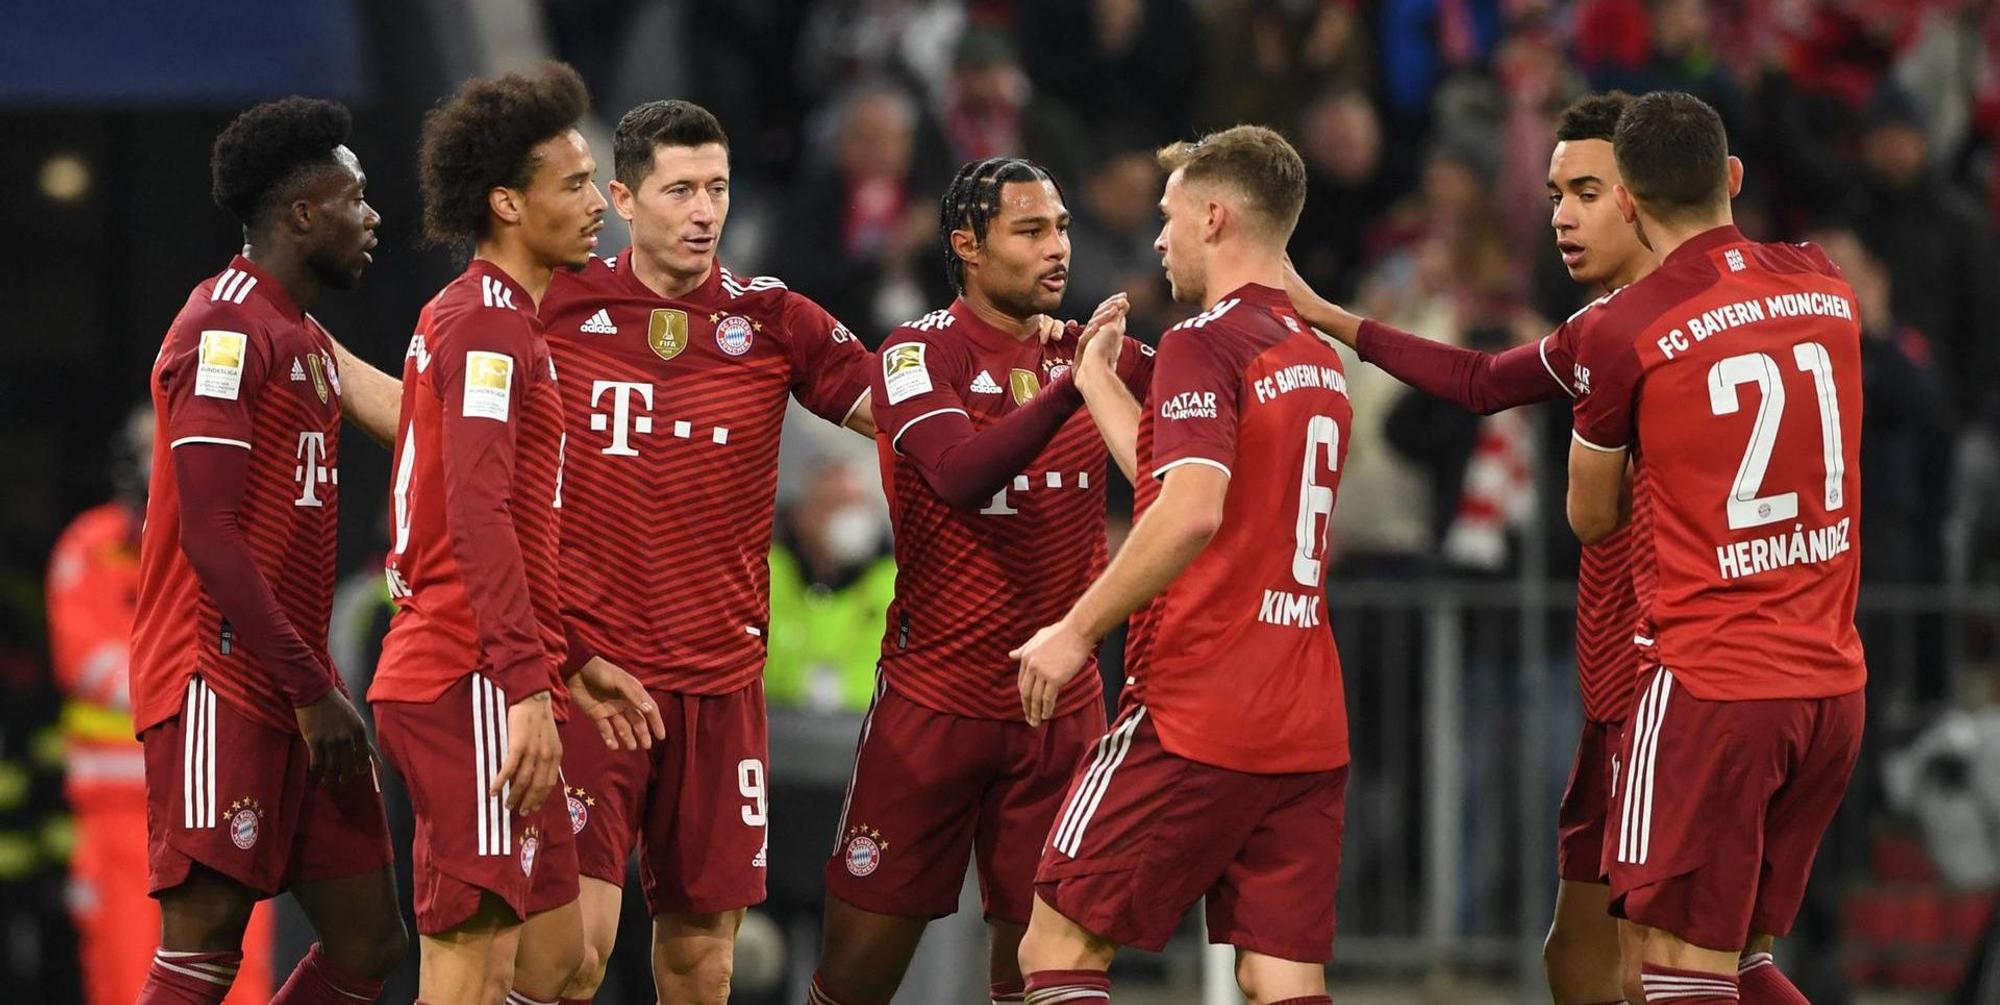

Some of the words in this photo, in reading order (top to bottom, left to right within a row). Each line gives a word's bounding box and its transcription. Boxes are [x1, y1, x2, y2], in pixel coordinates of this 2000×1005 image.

[580, 324, 617, 335] adidas
[1656, 329, 1690, 360] FC
[1687, 299, 1765, 342] BAYERN
[1765, 292, 1852, 321] MÜNCHEN
[1162, 391, 1217, 418] QATAR
[1254, 376, 1277, 404] FC
[1275, 364, 1320, 394] BAYERN
[1708, 342, 1844, 530] 21
[1292, 415, 1339, 587] 6
[1717, 517, 1850, 580] HERNÁNDEZ
[738, 759, 766, 827] 9
